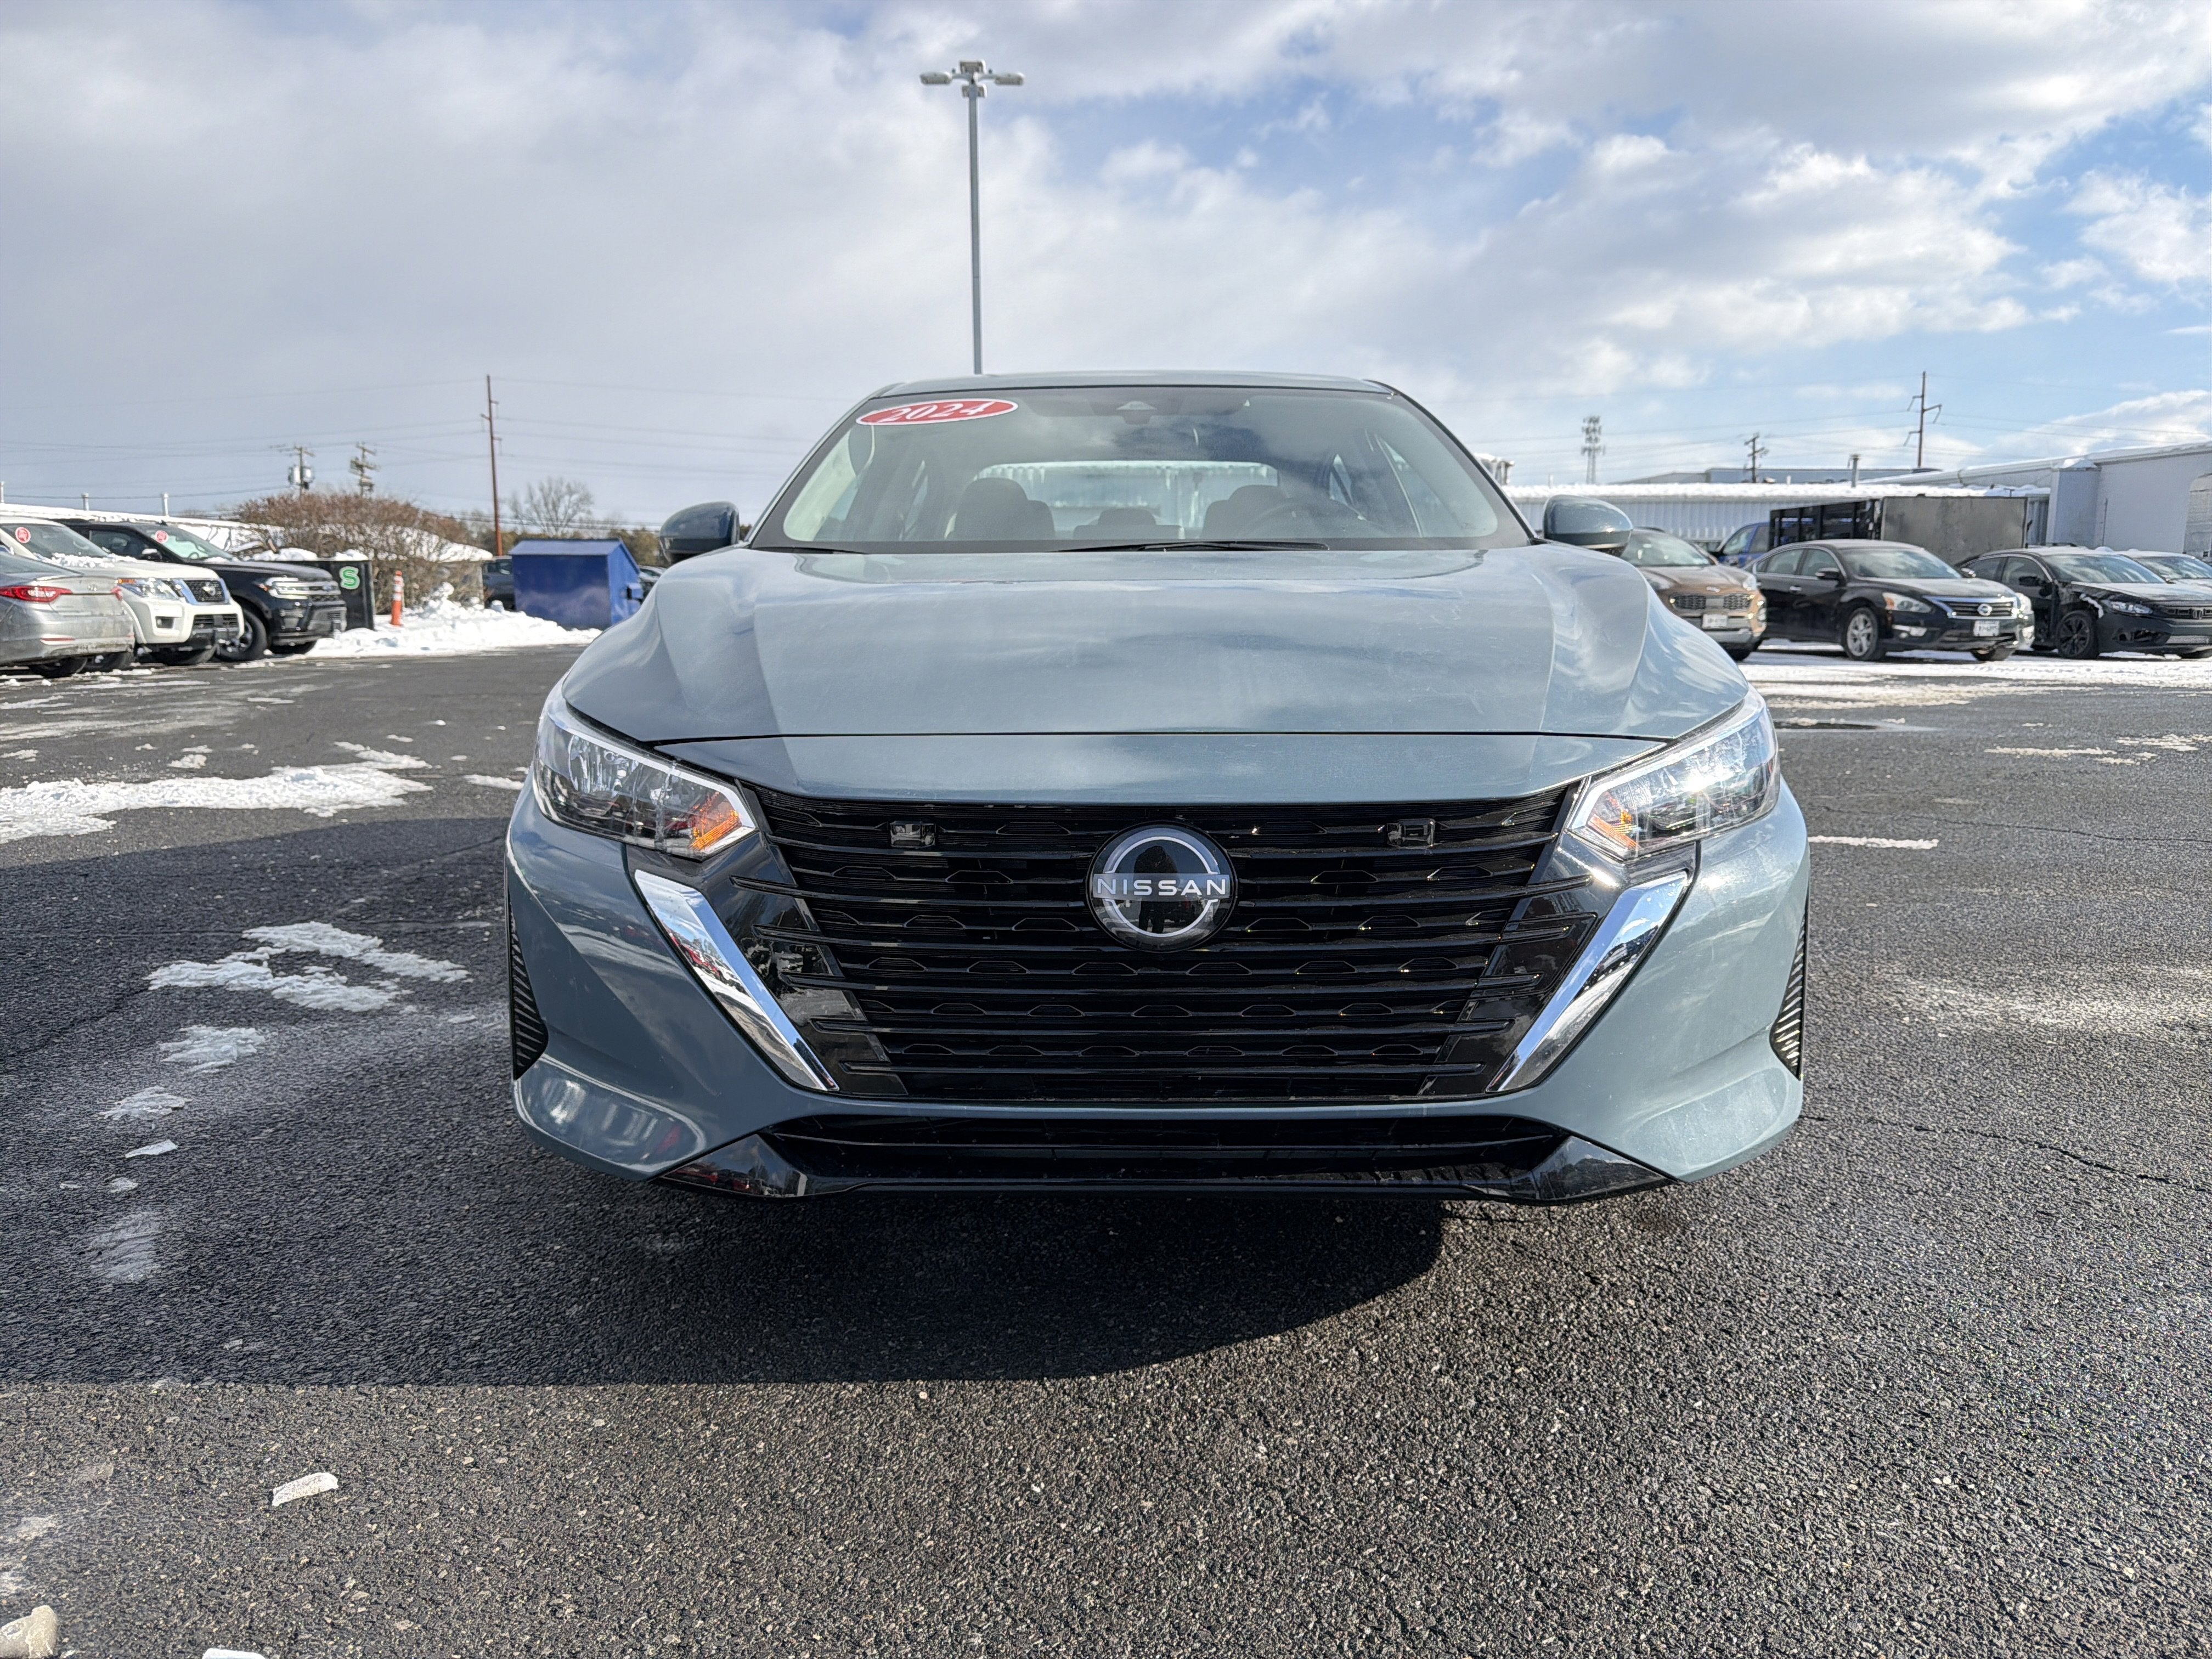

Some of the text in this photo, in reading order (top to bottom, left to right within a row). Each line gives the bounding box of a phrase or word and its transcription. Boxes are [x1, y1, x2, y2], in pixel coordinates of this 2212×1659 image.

[876, 402, 995, 424] 2024
[340, 566, 359, 589] S
[1097, 879, 1226, 896] NISSAN
